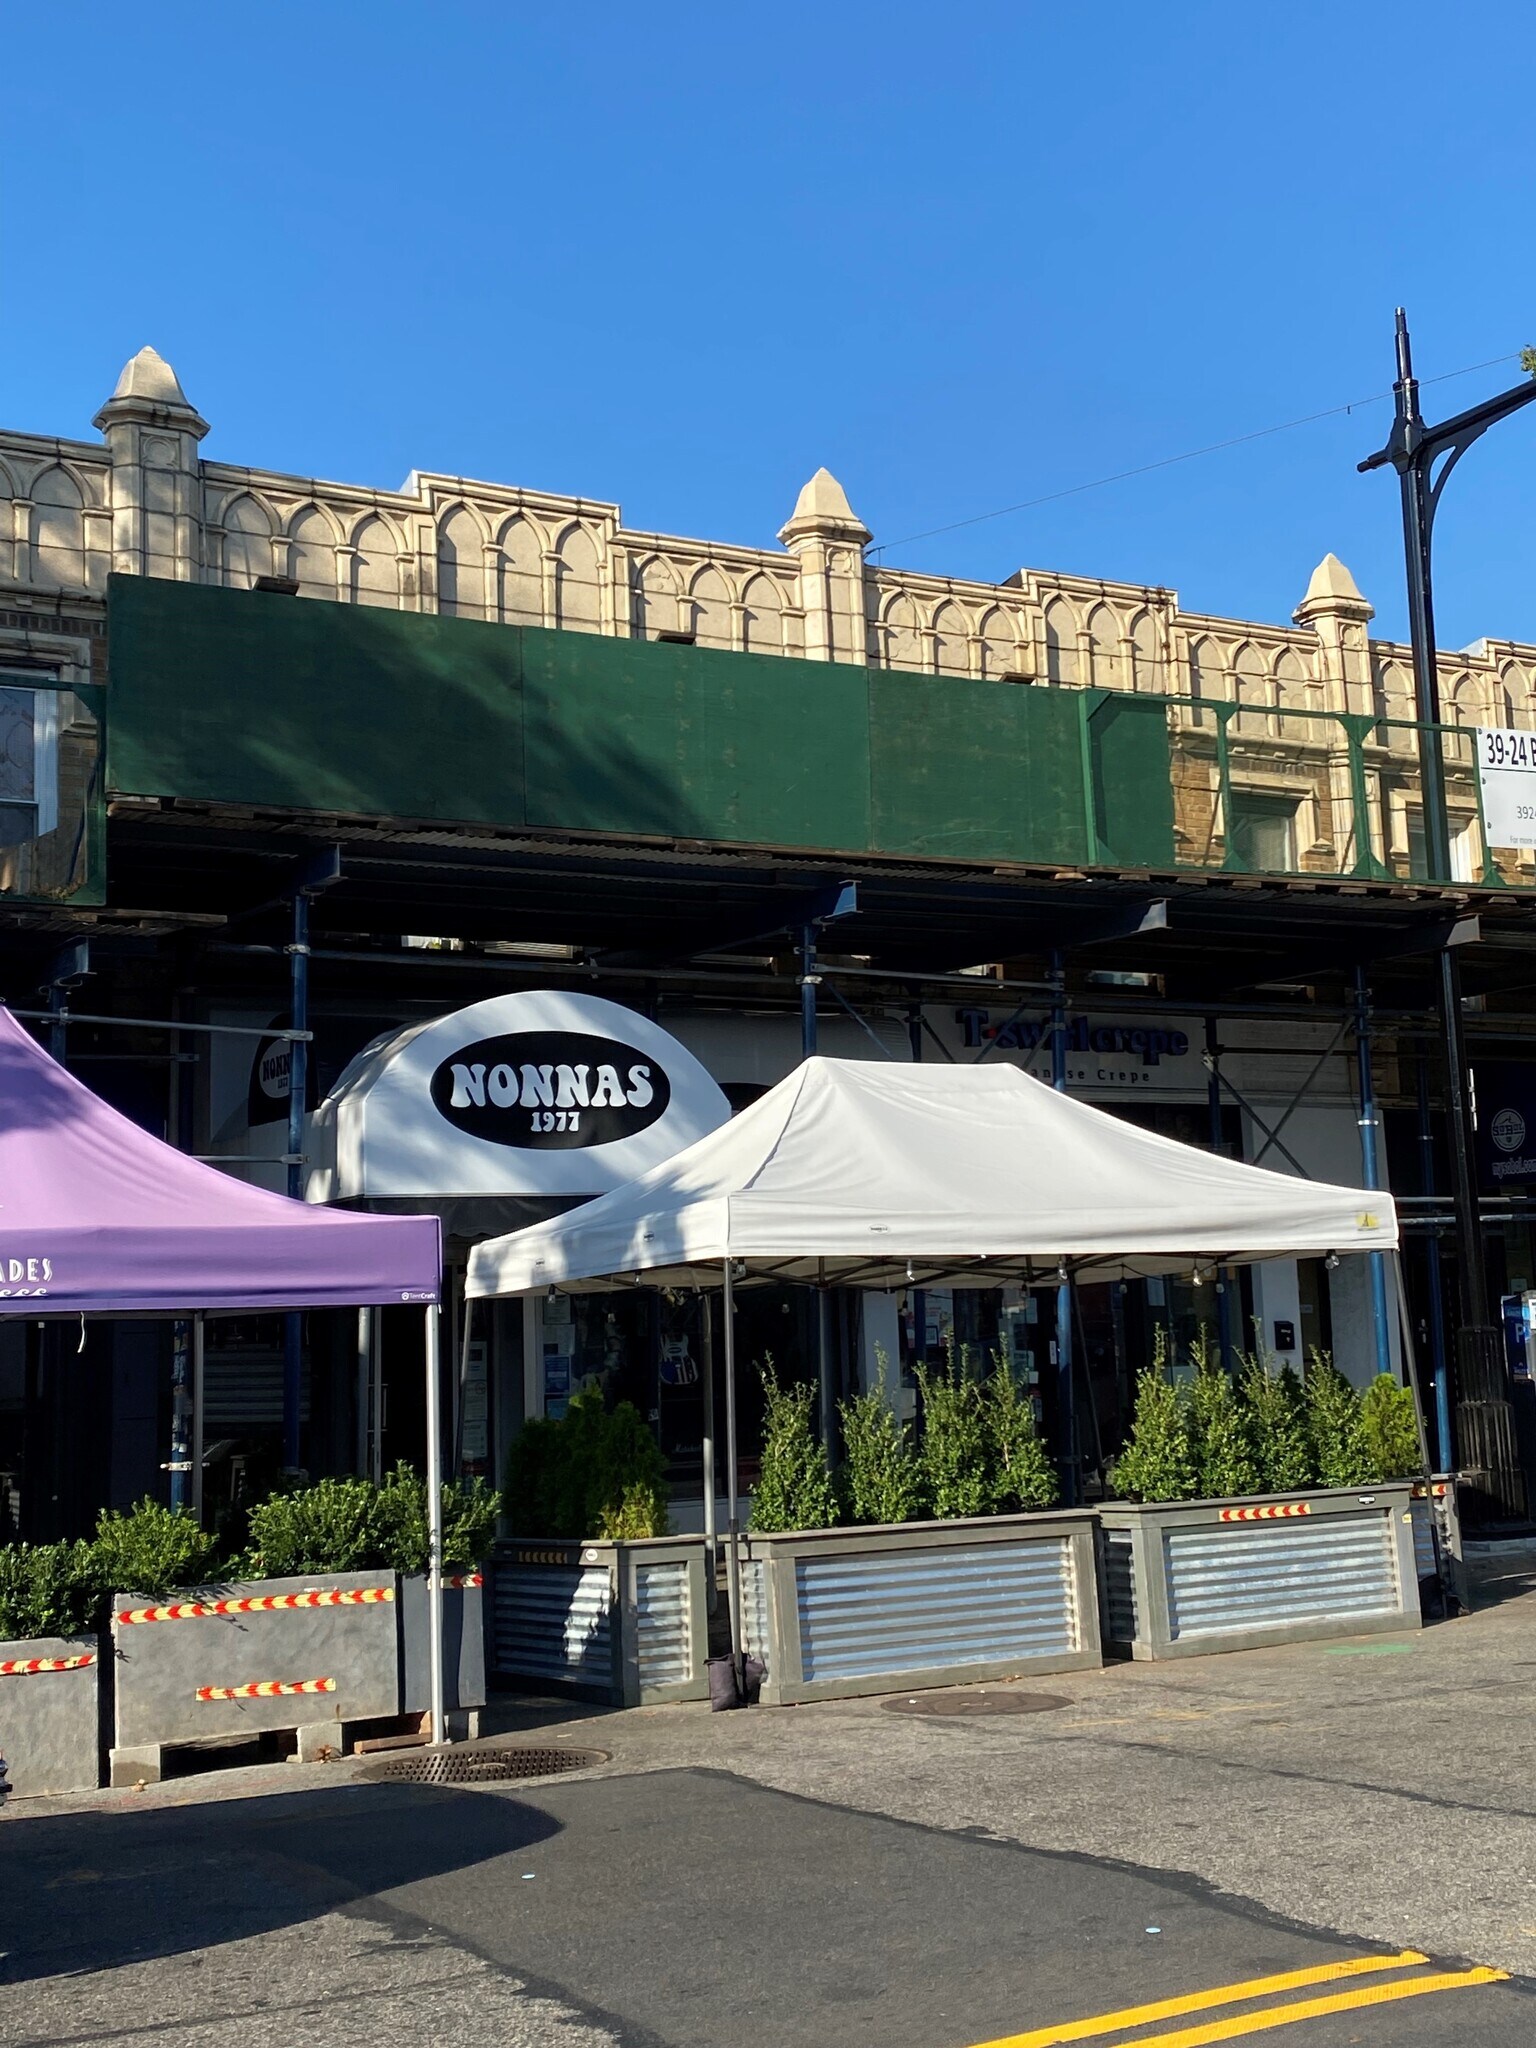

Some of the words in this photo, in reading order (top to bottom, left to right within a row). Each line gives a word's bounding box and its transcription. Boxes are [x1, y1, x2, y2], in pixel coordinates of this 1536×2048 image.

[1486, 733, 1527, 766] 39-24
[1516, 805, 1536, 820] 392
[263, 1053, 291, 1082] NONN
[1097, 1069, 1150, 1083] Crepe
[450, 1063, 654, 1108] NONNAS
[530, 1111, 580, 1132] 1977
